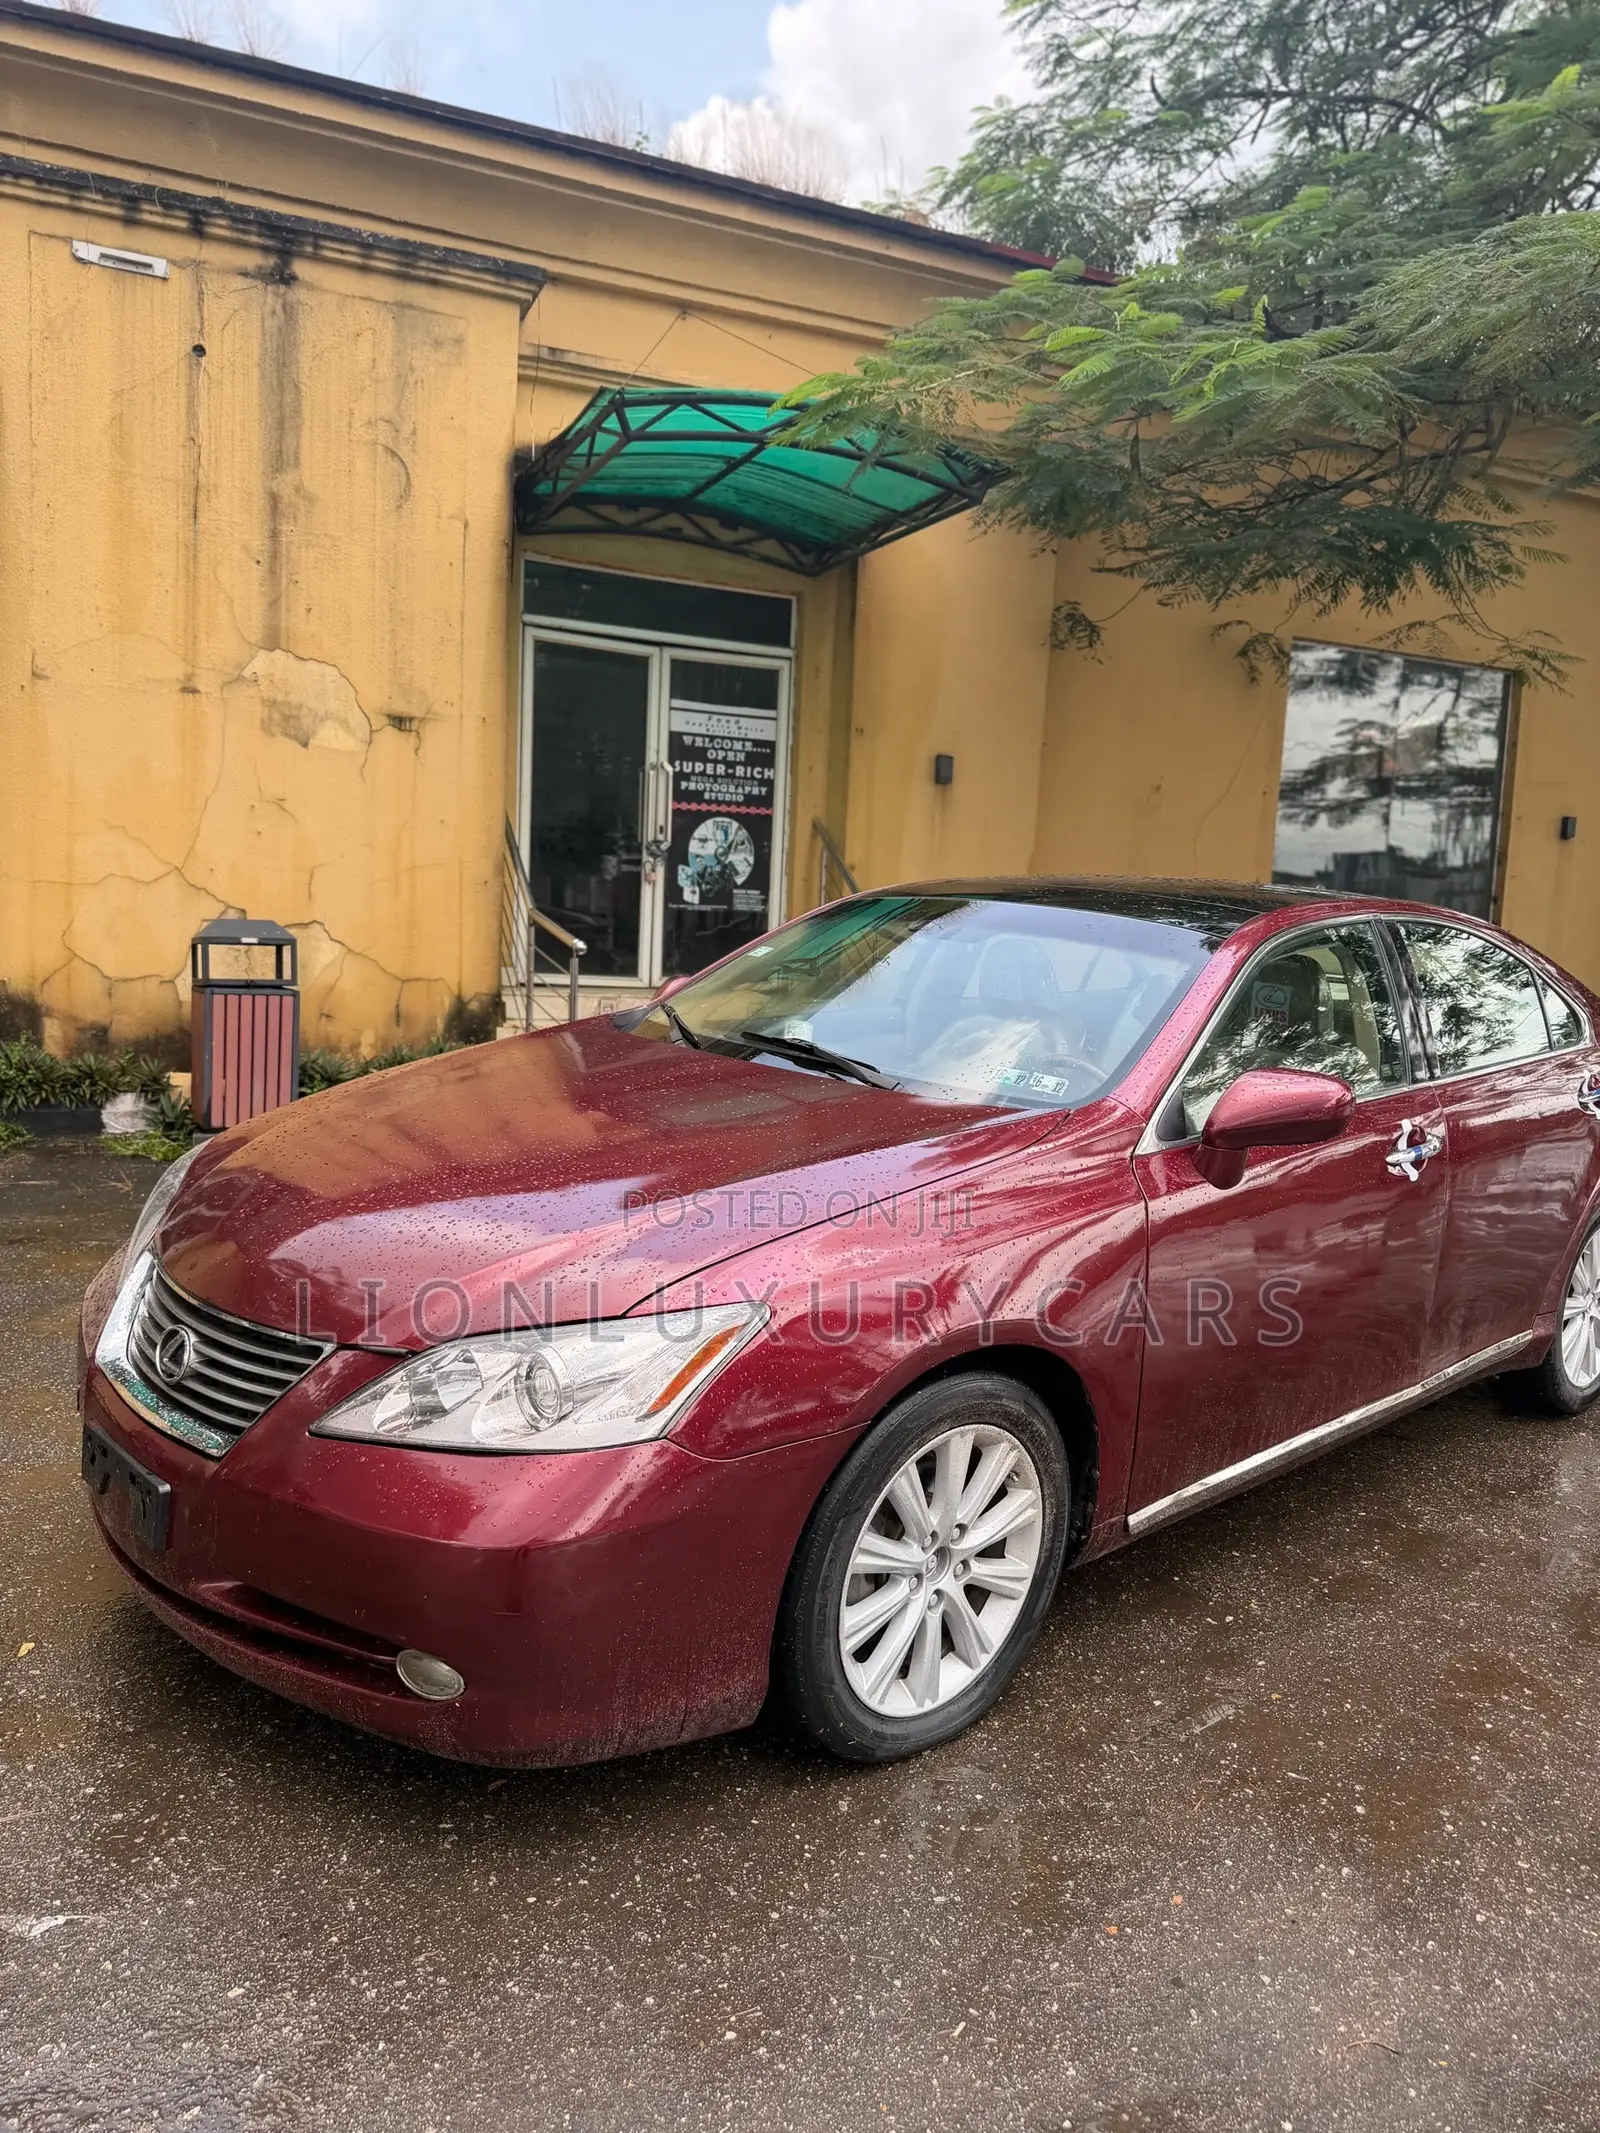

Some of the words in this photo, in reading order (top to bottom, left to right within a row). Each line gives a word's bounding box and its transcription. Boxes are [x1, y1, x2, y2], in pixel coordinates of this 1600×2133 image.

[706, 749, 746, 763] OPEN
[674, 760, 775, 780] SUPER-RICH
[690, 775, 714, 783] MEGA
[717, 778, 759, 786] SOLUTION
[680, 781, 768, 796] PHOTOGRAPHY
[703, 791, 745, 802] STUDIO
[1012, 1073, 1028, 1086] 12
[1051, 1081, 1066, 1093] 12
